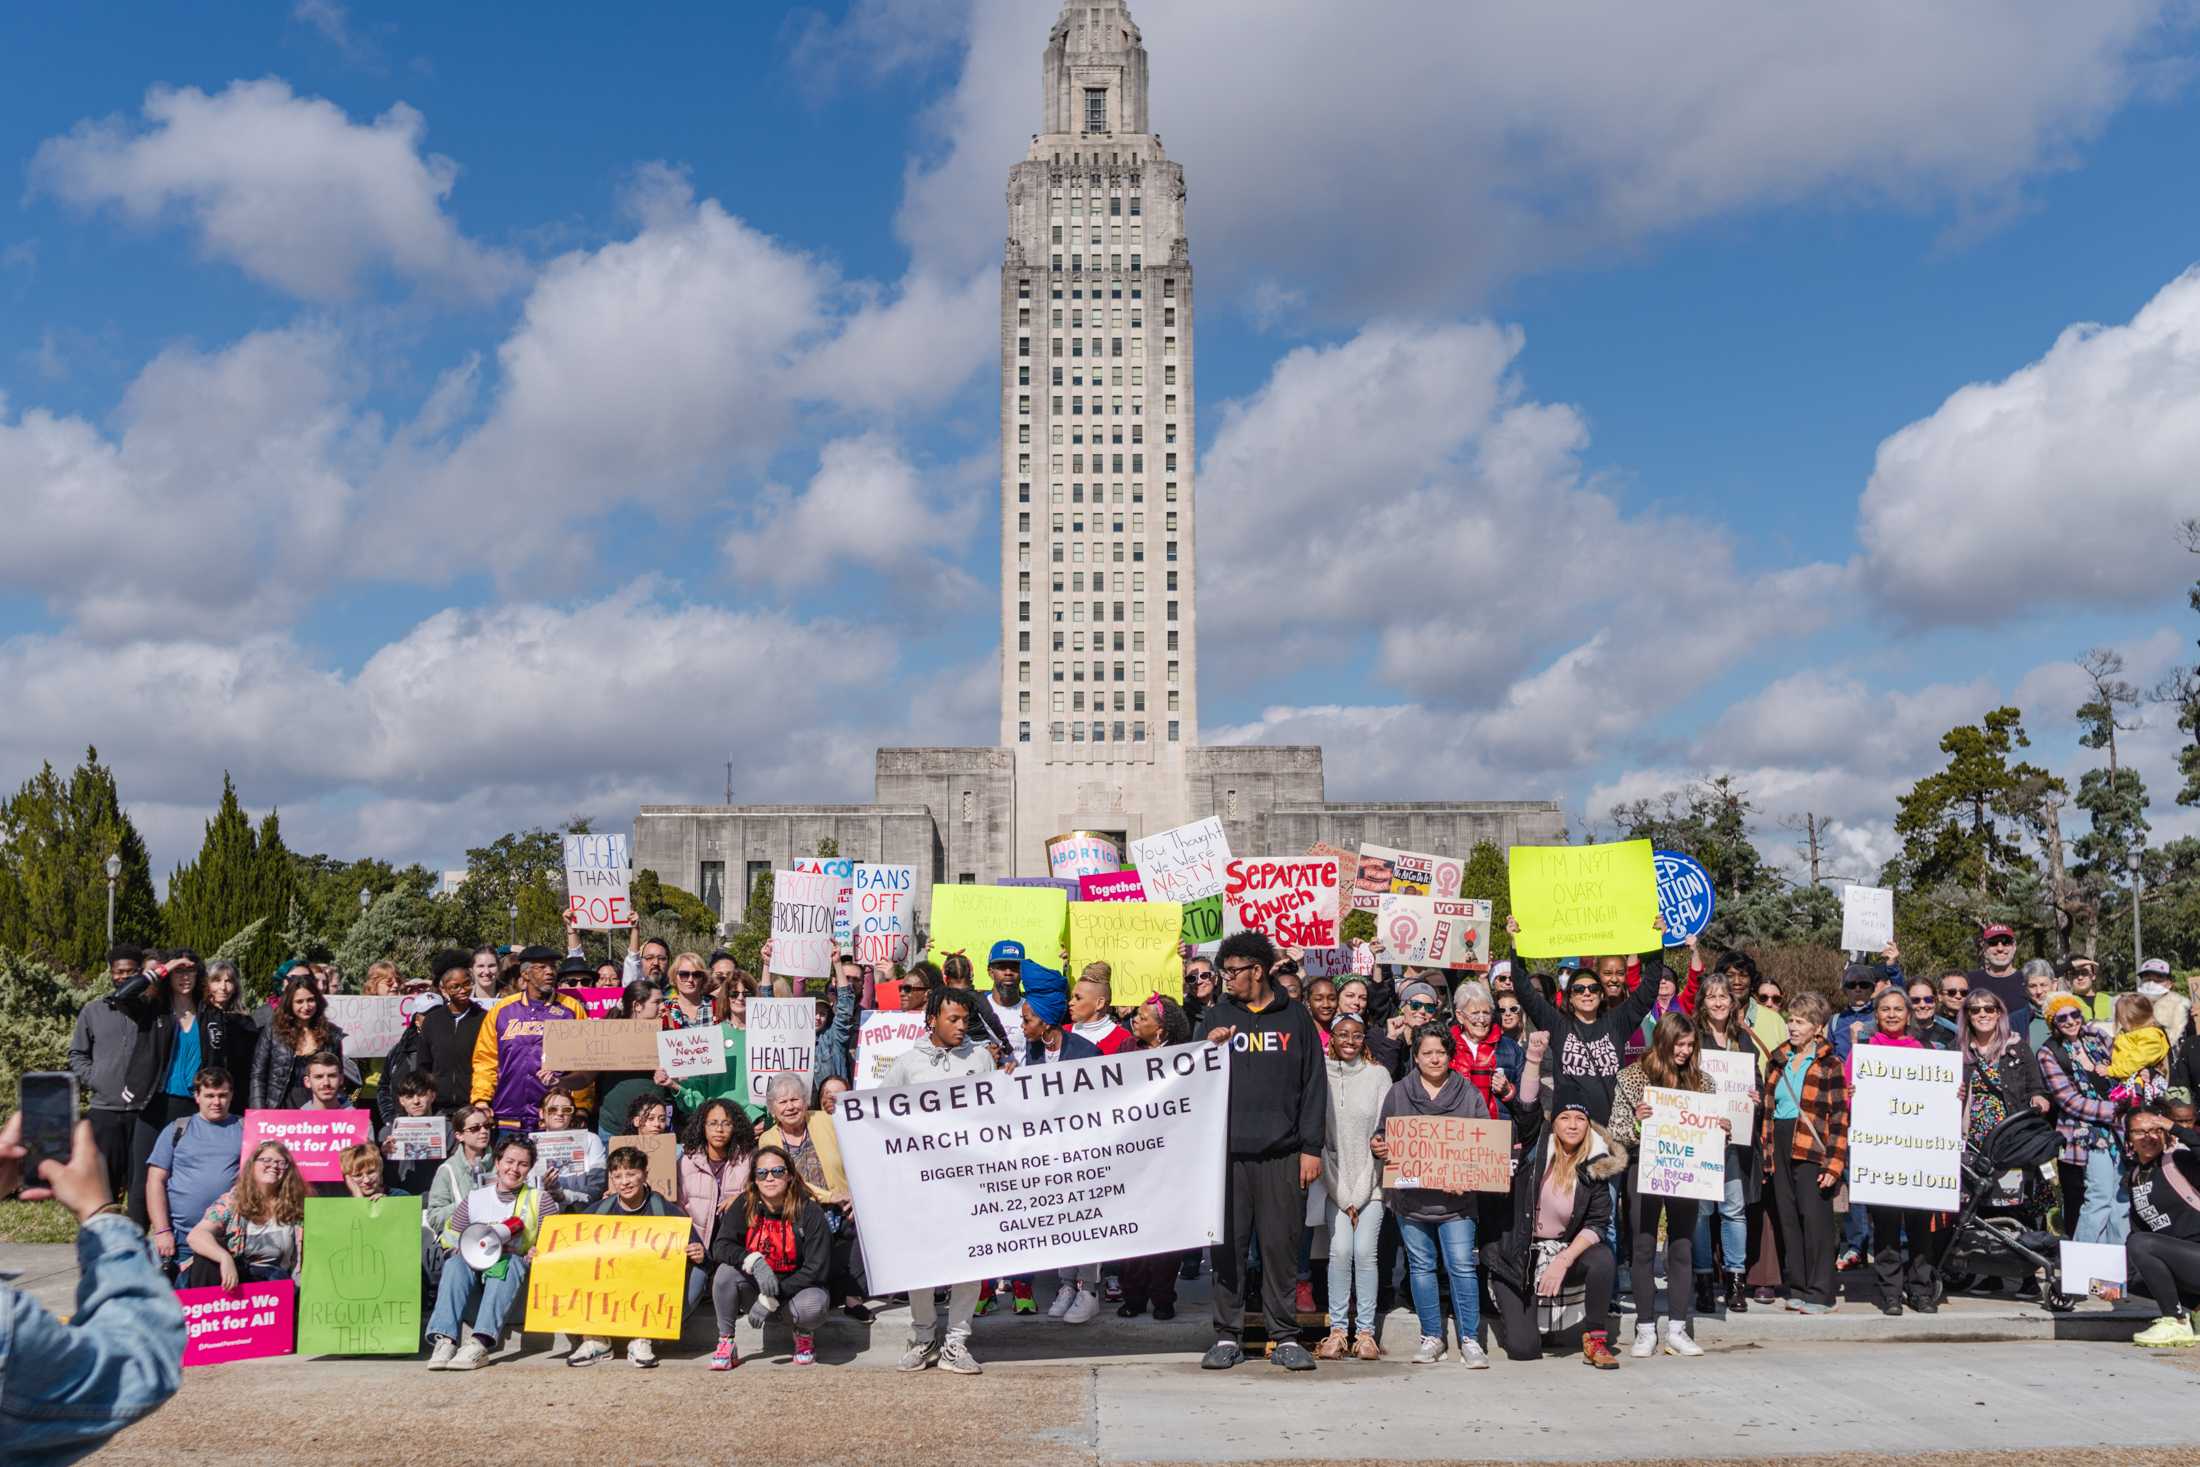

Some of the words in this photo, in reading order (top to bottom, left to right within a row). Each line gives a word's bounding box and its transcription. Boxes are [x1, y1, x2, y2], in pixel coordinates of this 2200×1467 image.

[563, 835, 627, 868] BIGGER
[1134, 843, 1165, 862] You
[1163, 825, 1225, 850] Thought
[1398, 856, 1432, 870] VOTE
[573, 870, 622, 886] THAN
[857, 869, 910, 890] BANS
[1089, 881, 1141, 897] Together
[1152, 862, 1217, 895] NASTY
[862, 893, 904, 912] OFF
[1226, 894, 1245, 907] the
[1354, 896, 1379, 907] VOT
[1553, 881, 1604, 904] OVARY
[570, 895, 629, 925] ROE
[773, 900, 837, 934] ABORTION
[1239, 888, 1315, 928] Church
[1435, 903, 1472, 916] VOTE
[865, 916, 901, 933] OUR
[853, 934, 909, 963] BODIES
[1134, 937, 1161, 950] are
[1430, 921, 1449, 959] VOTE
[751, 1003, 815, 1030] ABORTION
[751, 1046, 810, 1071] HEALTH
[1859, 1058, 1954, 1083] Abuelita
[844, 1081, 996, 1121] BIGGER
[1014, 1062, 1124, 1100] THAN
[1146, 1046, 1222, 1082] ROE
[1647, 1088, 1690, 1110] THINGS
[257, 1122, 328, 1136] Together
[331, 1121, 356, 1134] We
[885, 1130, 969, 1155] MARCH
[979, 1124, 1012, 1143] ON
[1022, 1111, 1102, 1138] BATON
[1112, 1097, 1192, 1125] ROUGE
[1387, 1119, 1404, 1138] NO
[1407, 1118, 1440, 1139] SEX
[303, 1139, 328, 1152] for
[329, 1139, 351, 1152] All
[1388, 1140, 1405, 1158] NO
[1658, 1140, 1695, 1157] DRIVE
[1851, 1129, 1964, 1151] Reproductive
[920, 1165, 974, 1182] BIGGER
[976, 1159, 1018, 1175] THAN
[1021, 1154, 1051, 1169] ROE
[1062, 1145, 1112, 1163] BATON
[1116, 1136, 1166, 1155] ROUGE
[1401, 1160, 1433, 1178] 60%
[979, 1179, 1018, 1193] "RISE
[1021, 1176, 1041, 1189] UP
[1045, 1172, 1073, 1186] FOR
[1076, 1165, 1111, 1182] ROE"
[1651, 1178, 1680, 1195] BABY
[1854, 1167, 1957, 1190] Freedom
[970, 1201, 1004, 1216] JAN.
[1007, 1198, 1027, 1212] 22,
[1030, 1193, 1064, 1208] 2023
[1068, 1190, 1085, 1203] AT
[1089, 1183, 1126, 1200] 12PM
[999, 1214, 1055, 1232] GALVEZ
[1058, 1207, 1103, 1224] PLAZA
[548, 1221, 683, 1260] ABORTION
[968, 1243, 993, 1258] 238
[997, 1235, 1047, 1254] NORTH
[1051, 1222, 1138, 1246] BOULEVARD
[594, 1257, 615, 1280] IS
[183, 1298, 249, 1318] ogether
[251, 1294, 279, 1308] We
[311, 1301, 413, 1325] REGULATE
[184, 1320, 220, 1338] ight
[222, 1315, 248, 1330] for
[250, 1311, 275, 1327] All
[332, 1326, 385, 1353] THIS.
